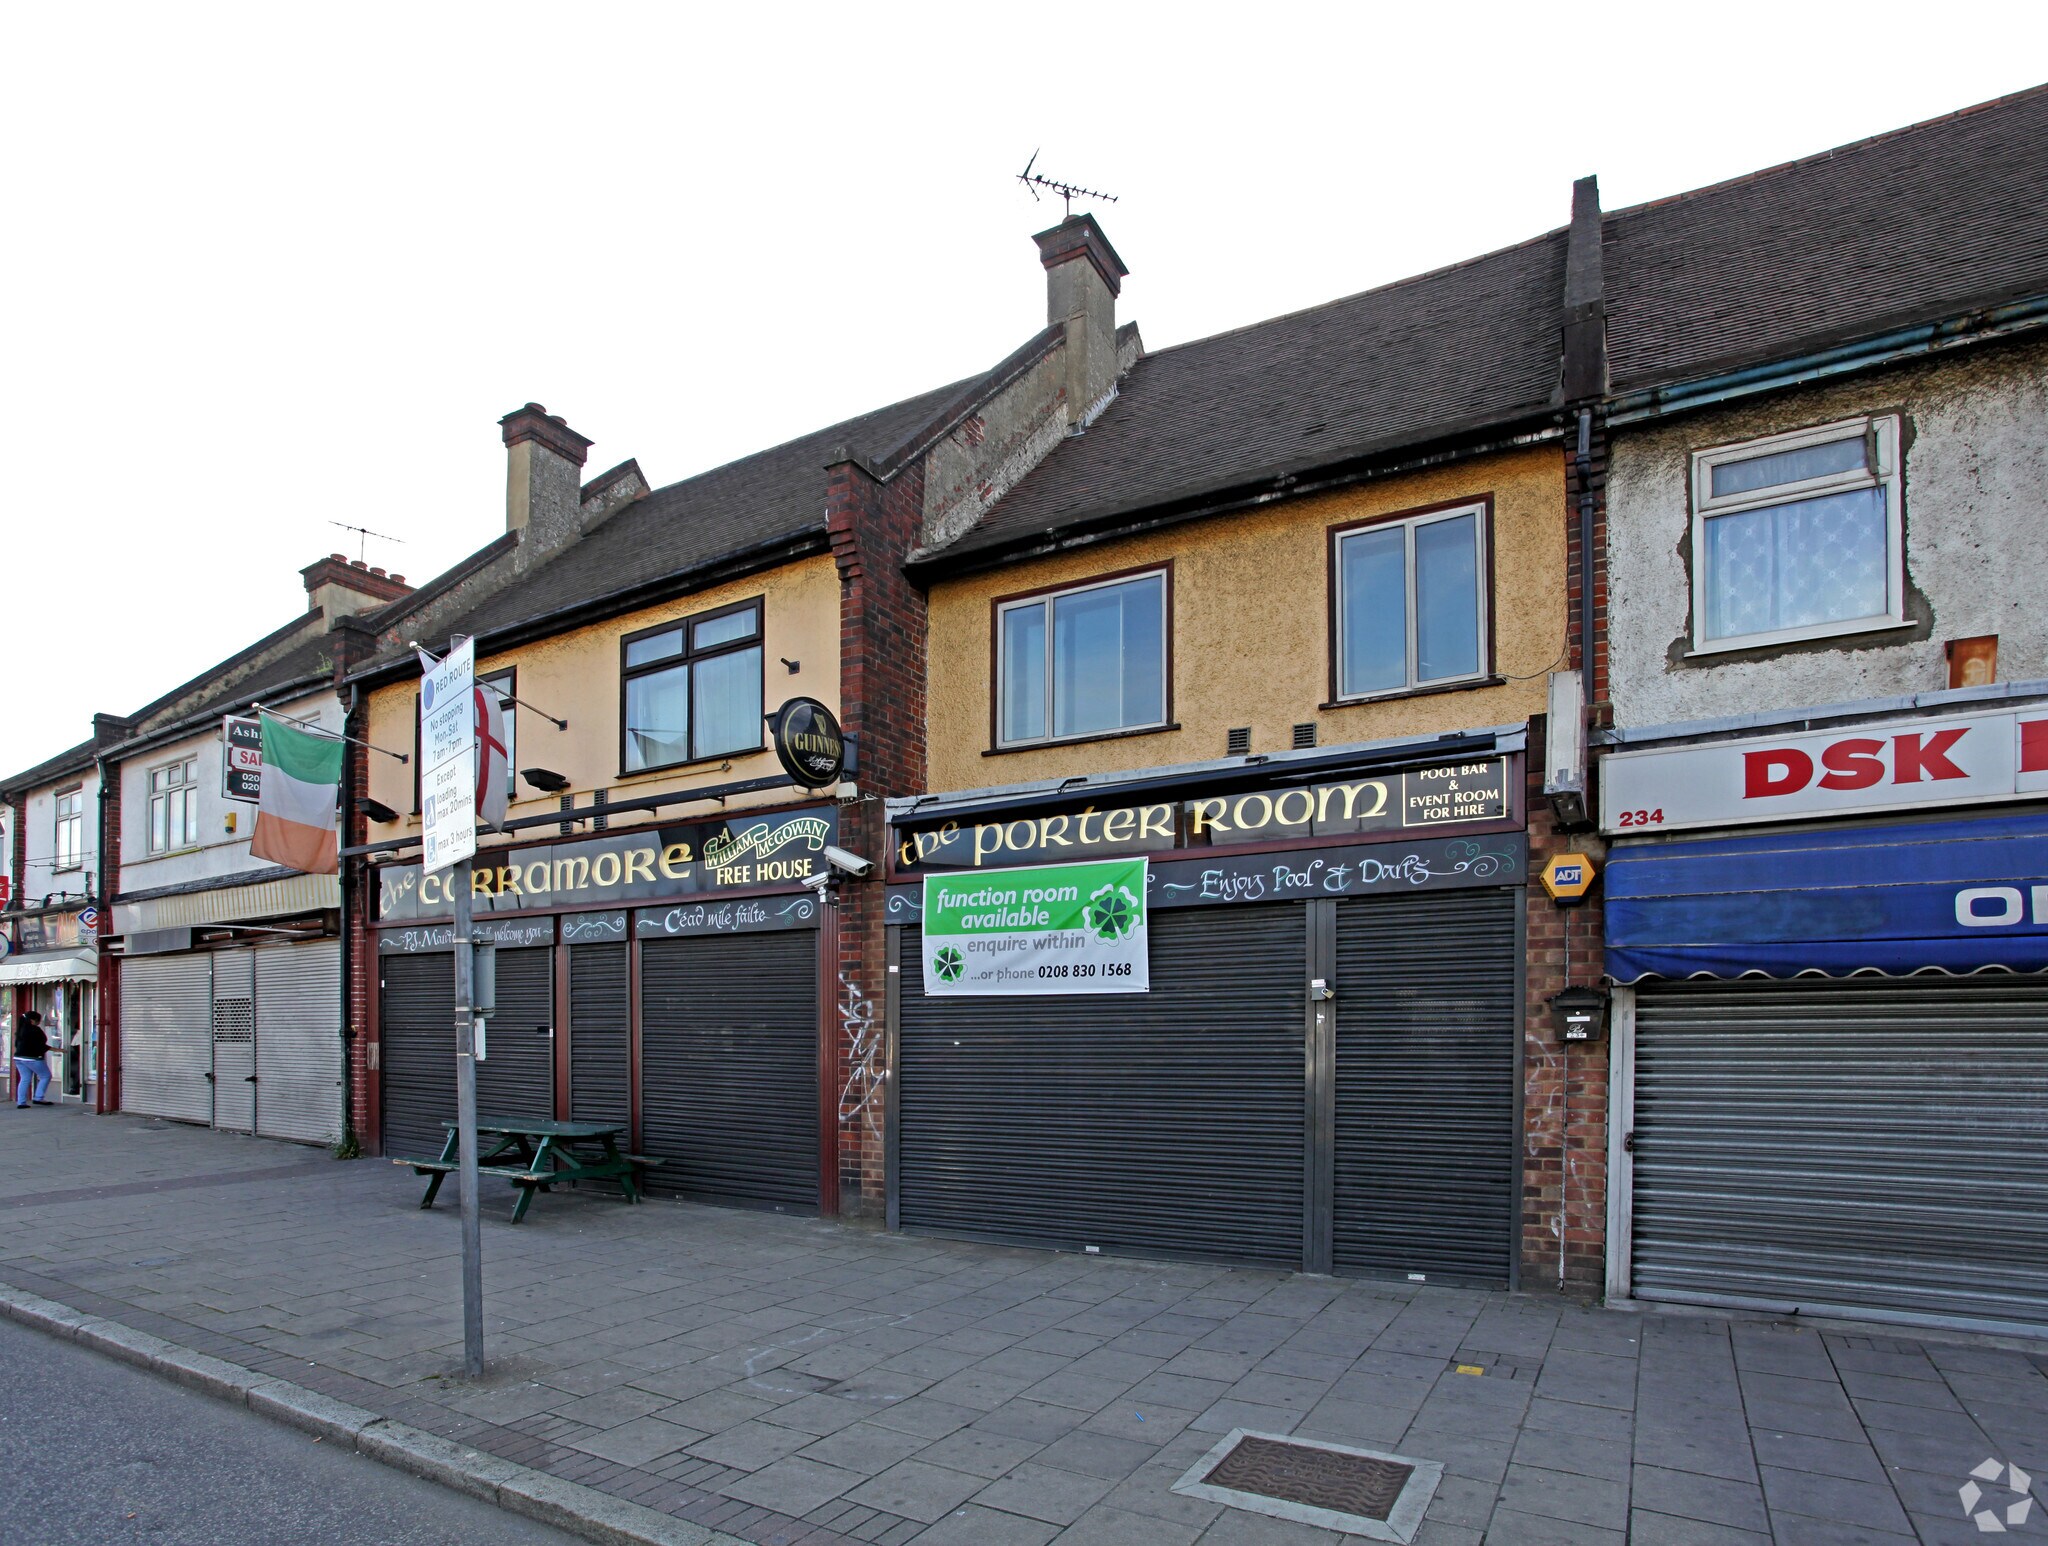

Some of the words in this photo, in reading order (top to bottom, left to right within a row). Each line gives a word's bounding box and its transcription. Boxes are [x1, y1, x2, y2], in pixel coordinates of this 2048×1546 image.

[435, 676, 448, 694] RED
[449, 658, 471, 684] ROUTE
[430, 719, 439, 732] No
[439, 702, 463, 727] stopping
[233, 726, 262, 739] Ash
[1420, 767, 1457, 780] POOL
[1461, 763, 1488, 776] BAR
[1741, 727, 1972, 800] DSK
[436, 765, 456, 786] Except
[1448, 780, 1459, 791] &
[436, 786, 457, 805] loading
[437, 807, 449, 818] max
[449, 795, 472, 813] 20mins
[1410, 793, 1450, 808] EVENT
[1454, 789, 1499, 803] ROOM
[1423, 807, 1450, 820] FOR
[1454, 803, 1485, 817] HIRE
[1619, 808, 1665, 828] 234
[437, 841, 449, 851] max
[450, 832, 455, 845] 3
[455, 827, 473, 842] hours
[718, 827, 731, 844] A
[708, 832, 754, 867] WILLIAM
[716, 865, 751, 885] FREE
[756, 858, 812, 881] HOUSE
[1199, 868, 1265, 901] Enjoy
[1273, 859, 1324, 892] Pool
[1358, 854, 1431, 885] Darts
[1555, 868, 1581, 883] ADT
[936, 887, 1016, 913] function
[1022, 886, 1078, 904] room
[961, 905, 1050, 929] available
[494, 921, 523, 941] welcome
[525, 927, 541, 944] you
[967, 935, 1028, 957] enquire
[1033, 933, 1086, 951] within
[996, 967, 1035, 983] phone
[1038, 965, 1069, 979] 0208
[1072, 964, 1096, 978] 830
[1101, 963, 1132, 977] 1568
